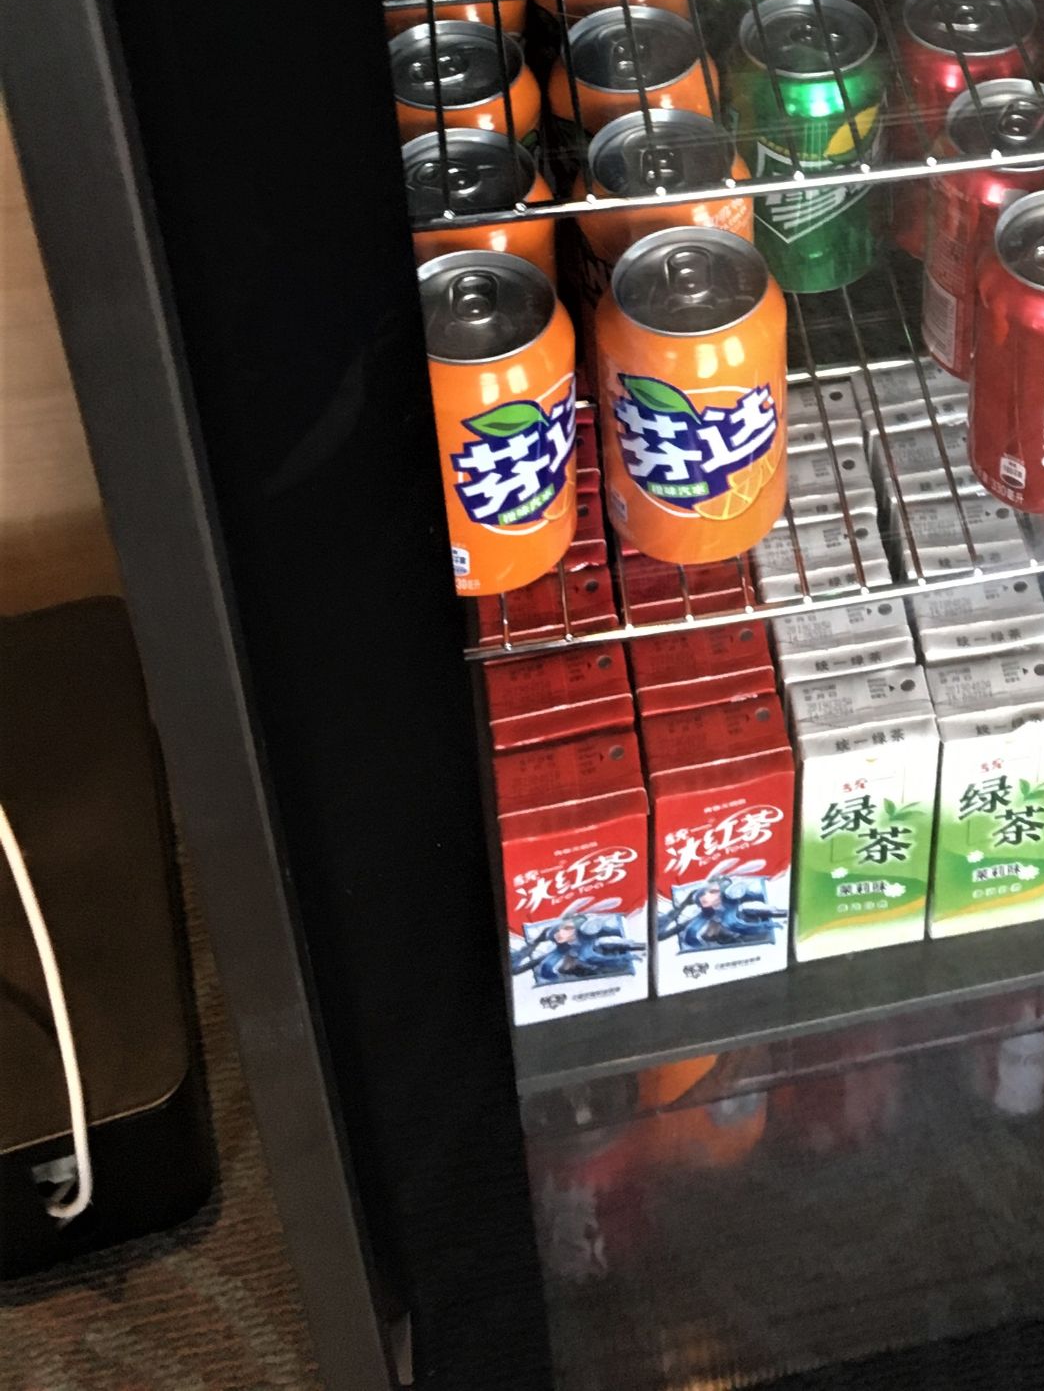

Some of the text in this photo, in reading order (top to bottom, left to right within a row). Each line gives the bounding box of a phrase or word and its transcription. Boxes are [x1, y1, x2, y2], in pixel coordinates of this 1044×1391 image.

[617, 388, 777, 480] 芬达
[664, 805, 784, 876] 冰红茶
[821, 794, 912, 864] 绿茶
[514, 846, 638, 913] 冰红茶
